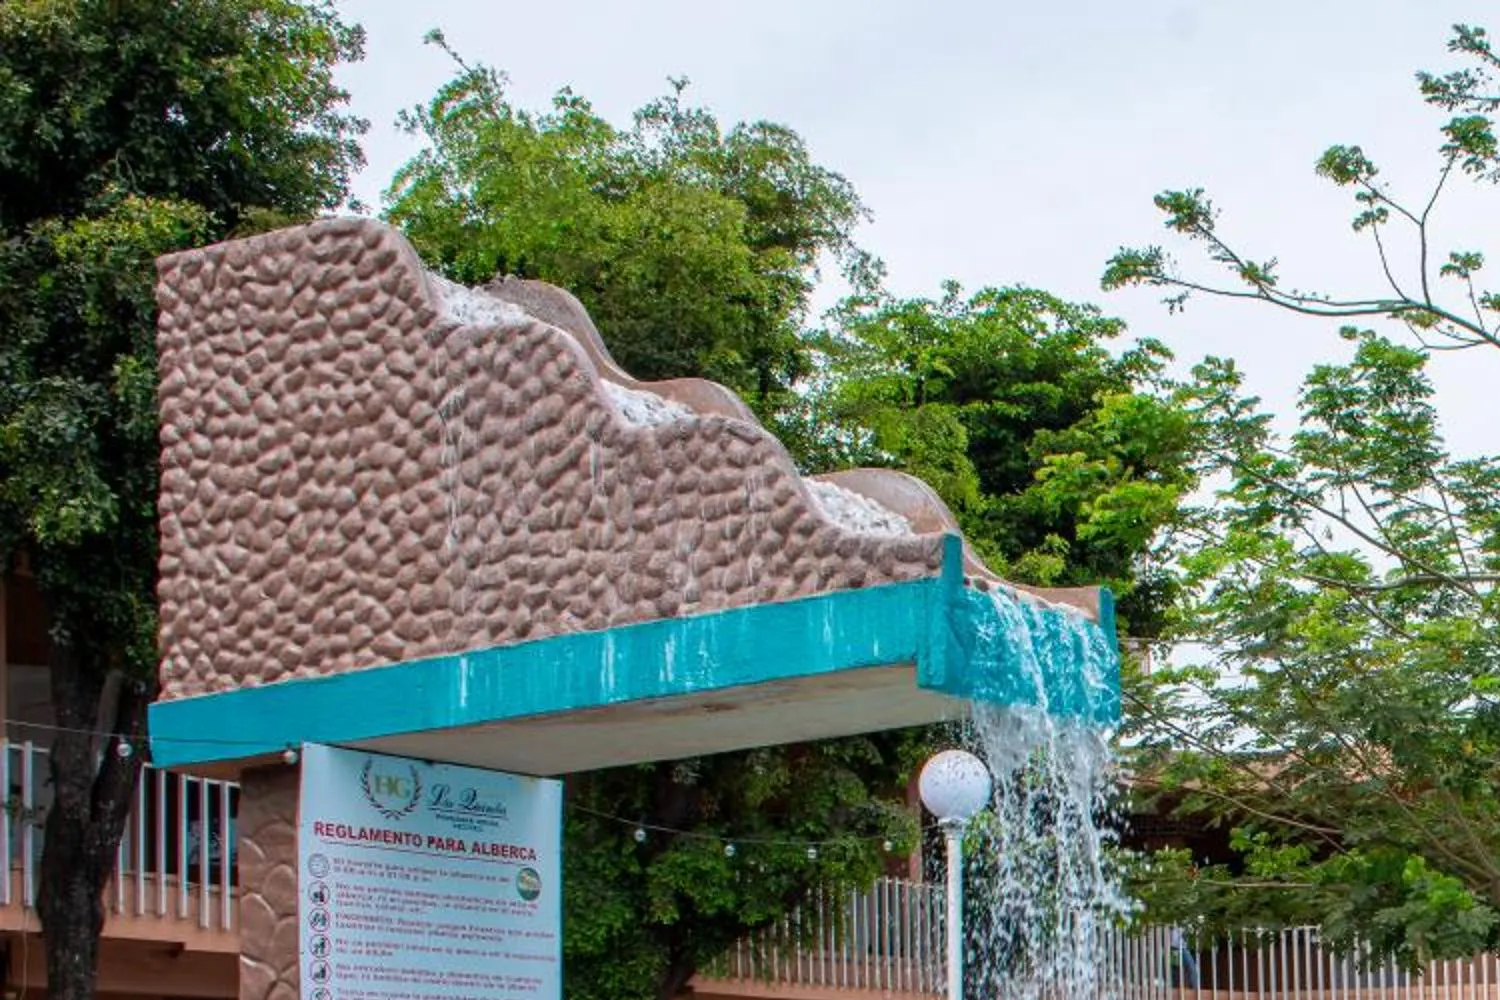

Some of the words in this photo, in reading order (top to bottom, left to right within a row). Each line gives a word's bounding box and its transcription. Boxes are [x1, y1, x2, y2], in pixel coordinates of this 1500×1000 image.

[313, 820, 423, 848] REGLAMENTO
[426, 835, 466, 853] PARA
[471, 841, 537, 861] ALBERCA
